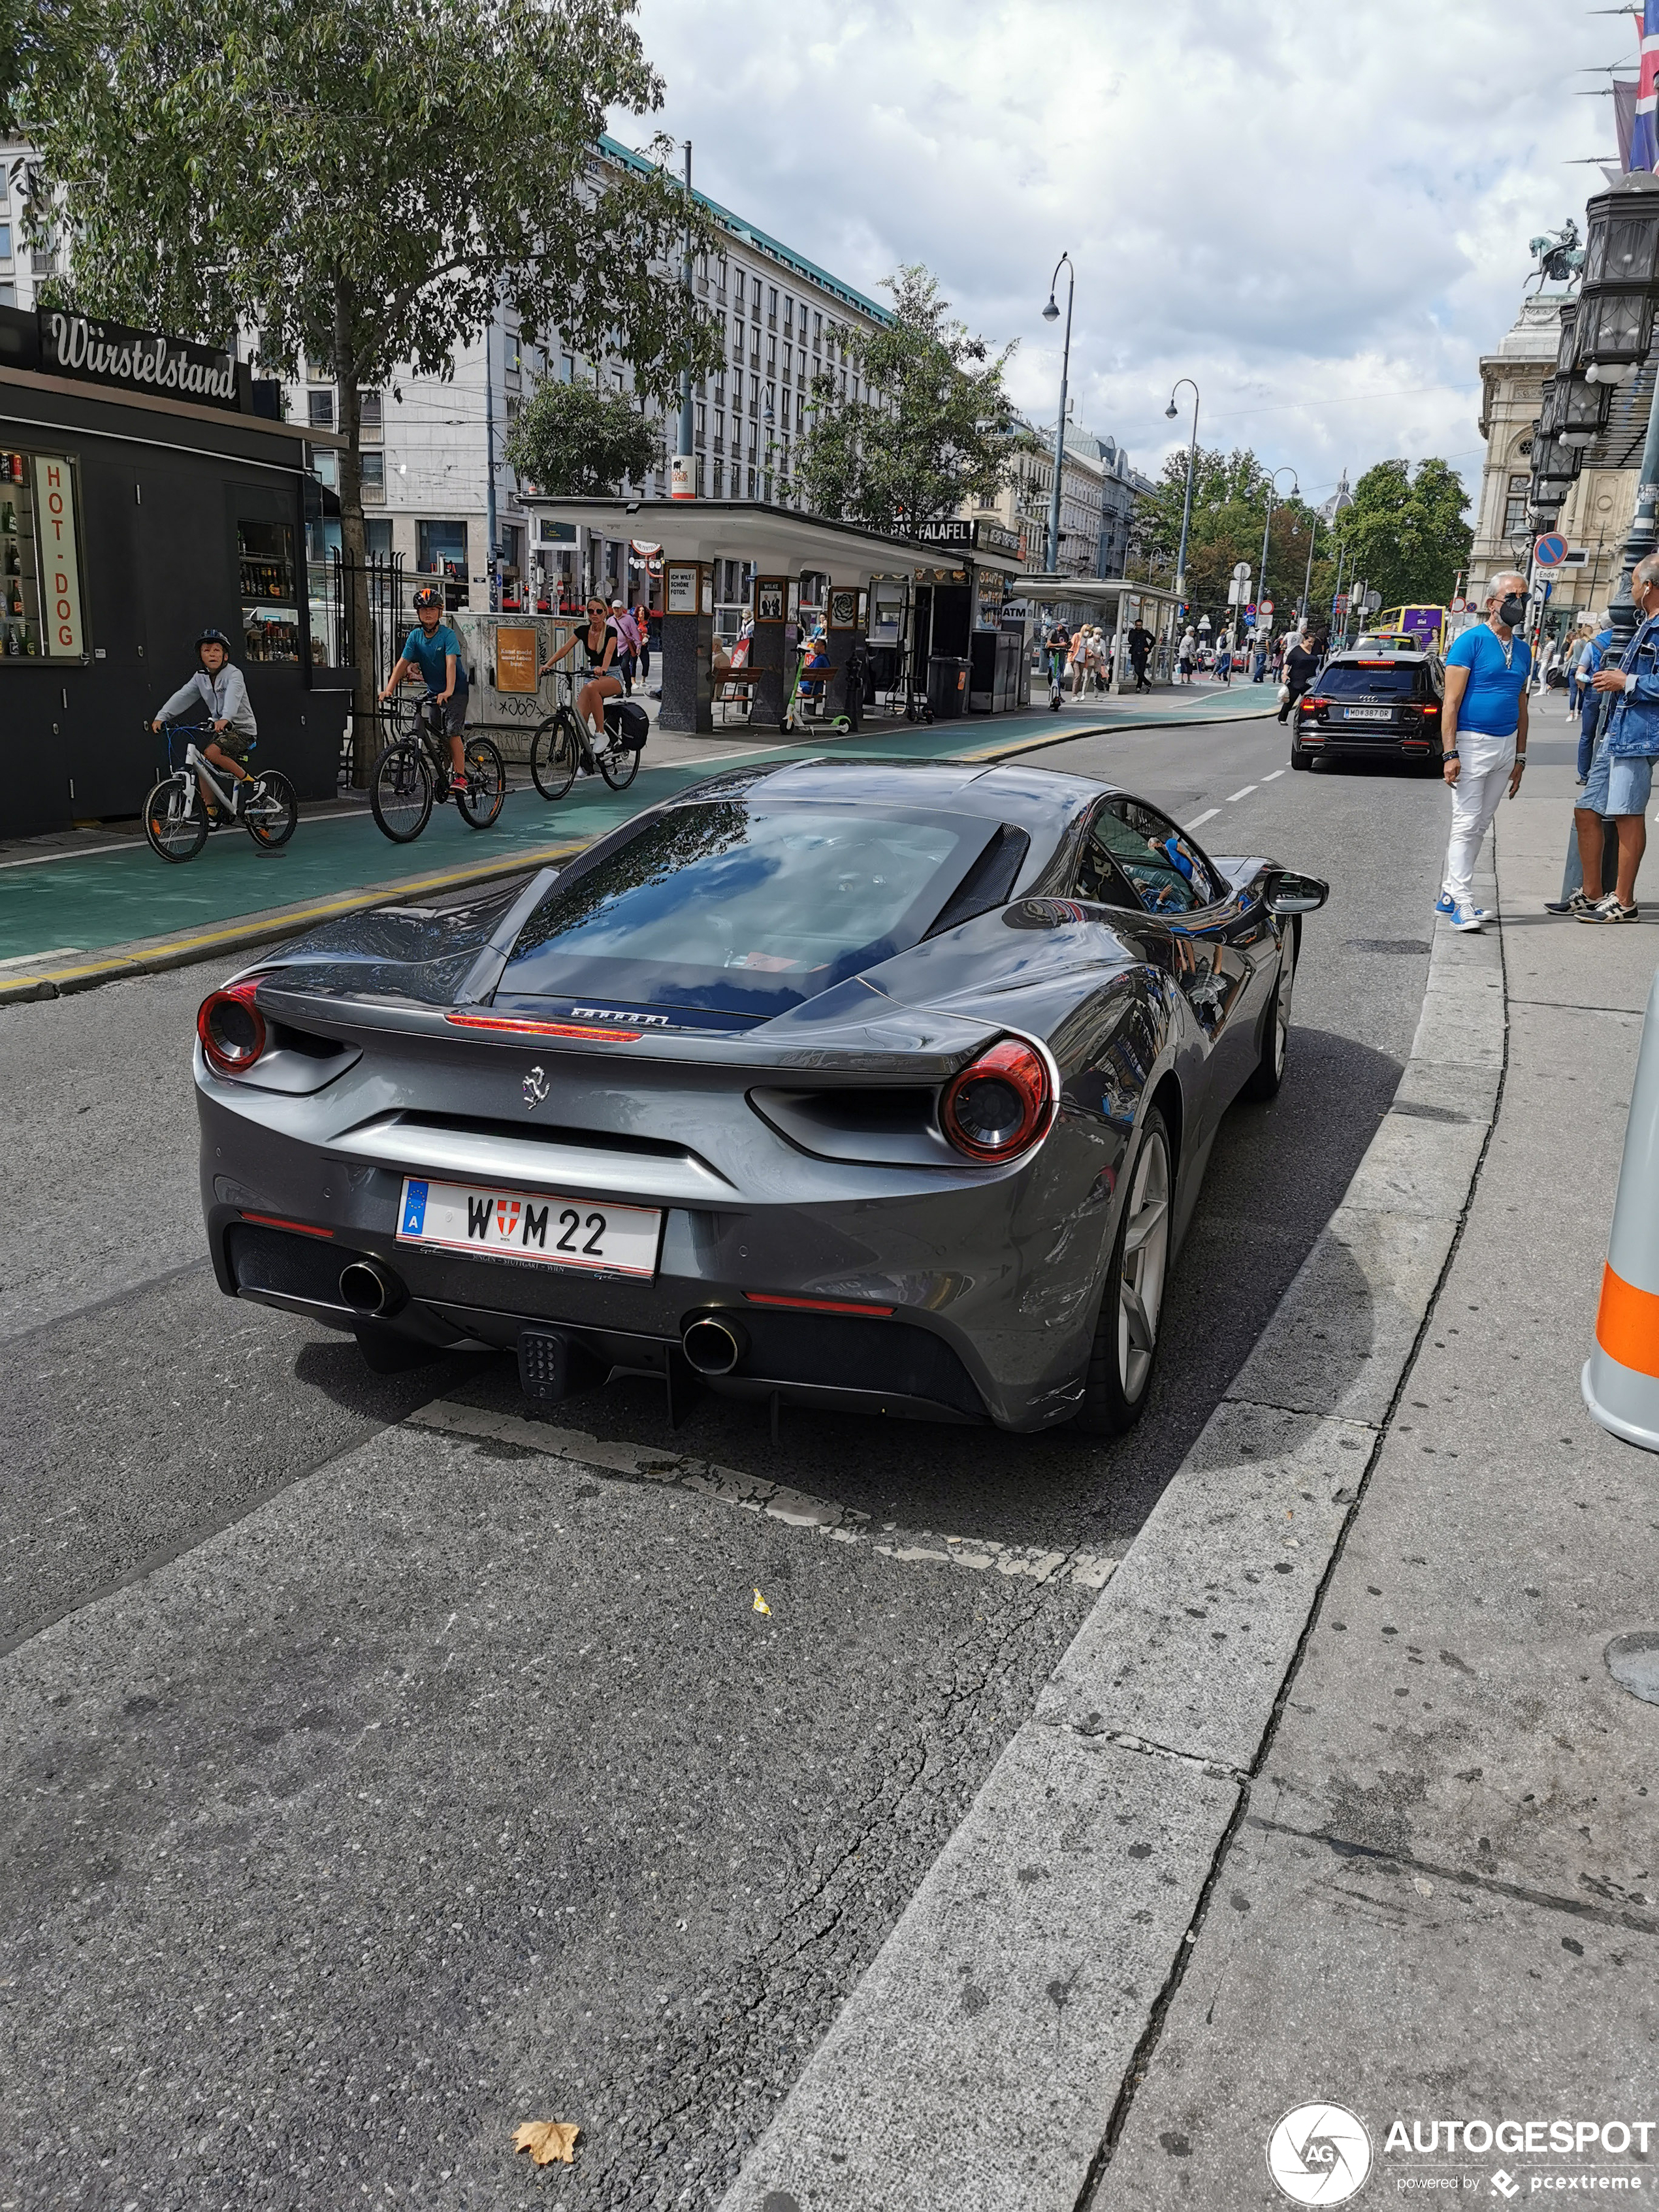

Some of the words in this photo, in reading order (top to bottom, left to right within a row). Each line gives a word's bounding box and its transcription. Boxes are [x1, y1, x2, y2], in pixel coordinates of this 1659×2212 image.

[52, 313, 236, 400] Würstelstand
[1003, 608, 1026, 617] ATM
[408, 1217, 419, 1228] A
[468, 1196, 493, 1240] W
[472, 1254, 496, 1264] SINGEN
[503, 1259, 540, 1270] STUTTGART
[547, 1264, 565, 1273] WIEN
